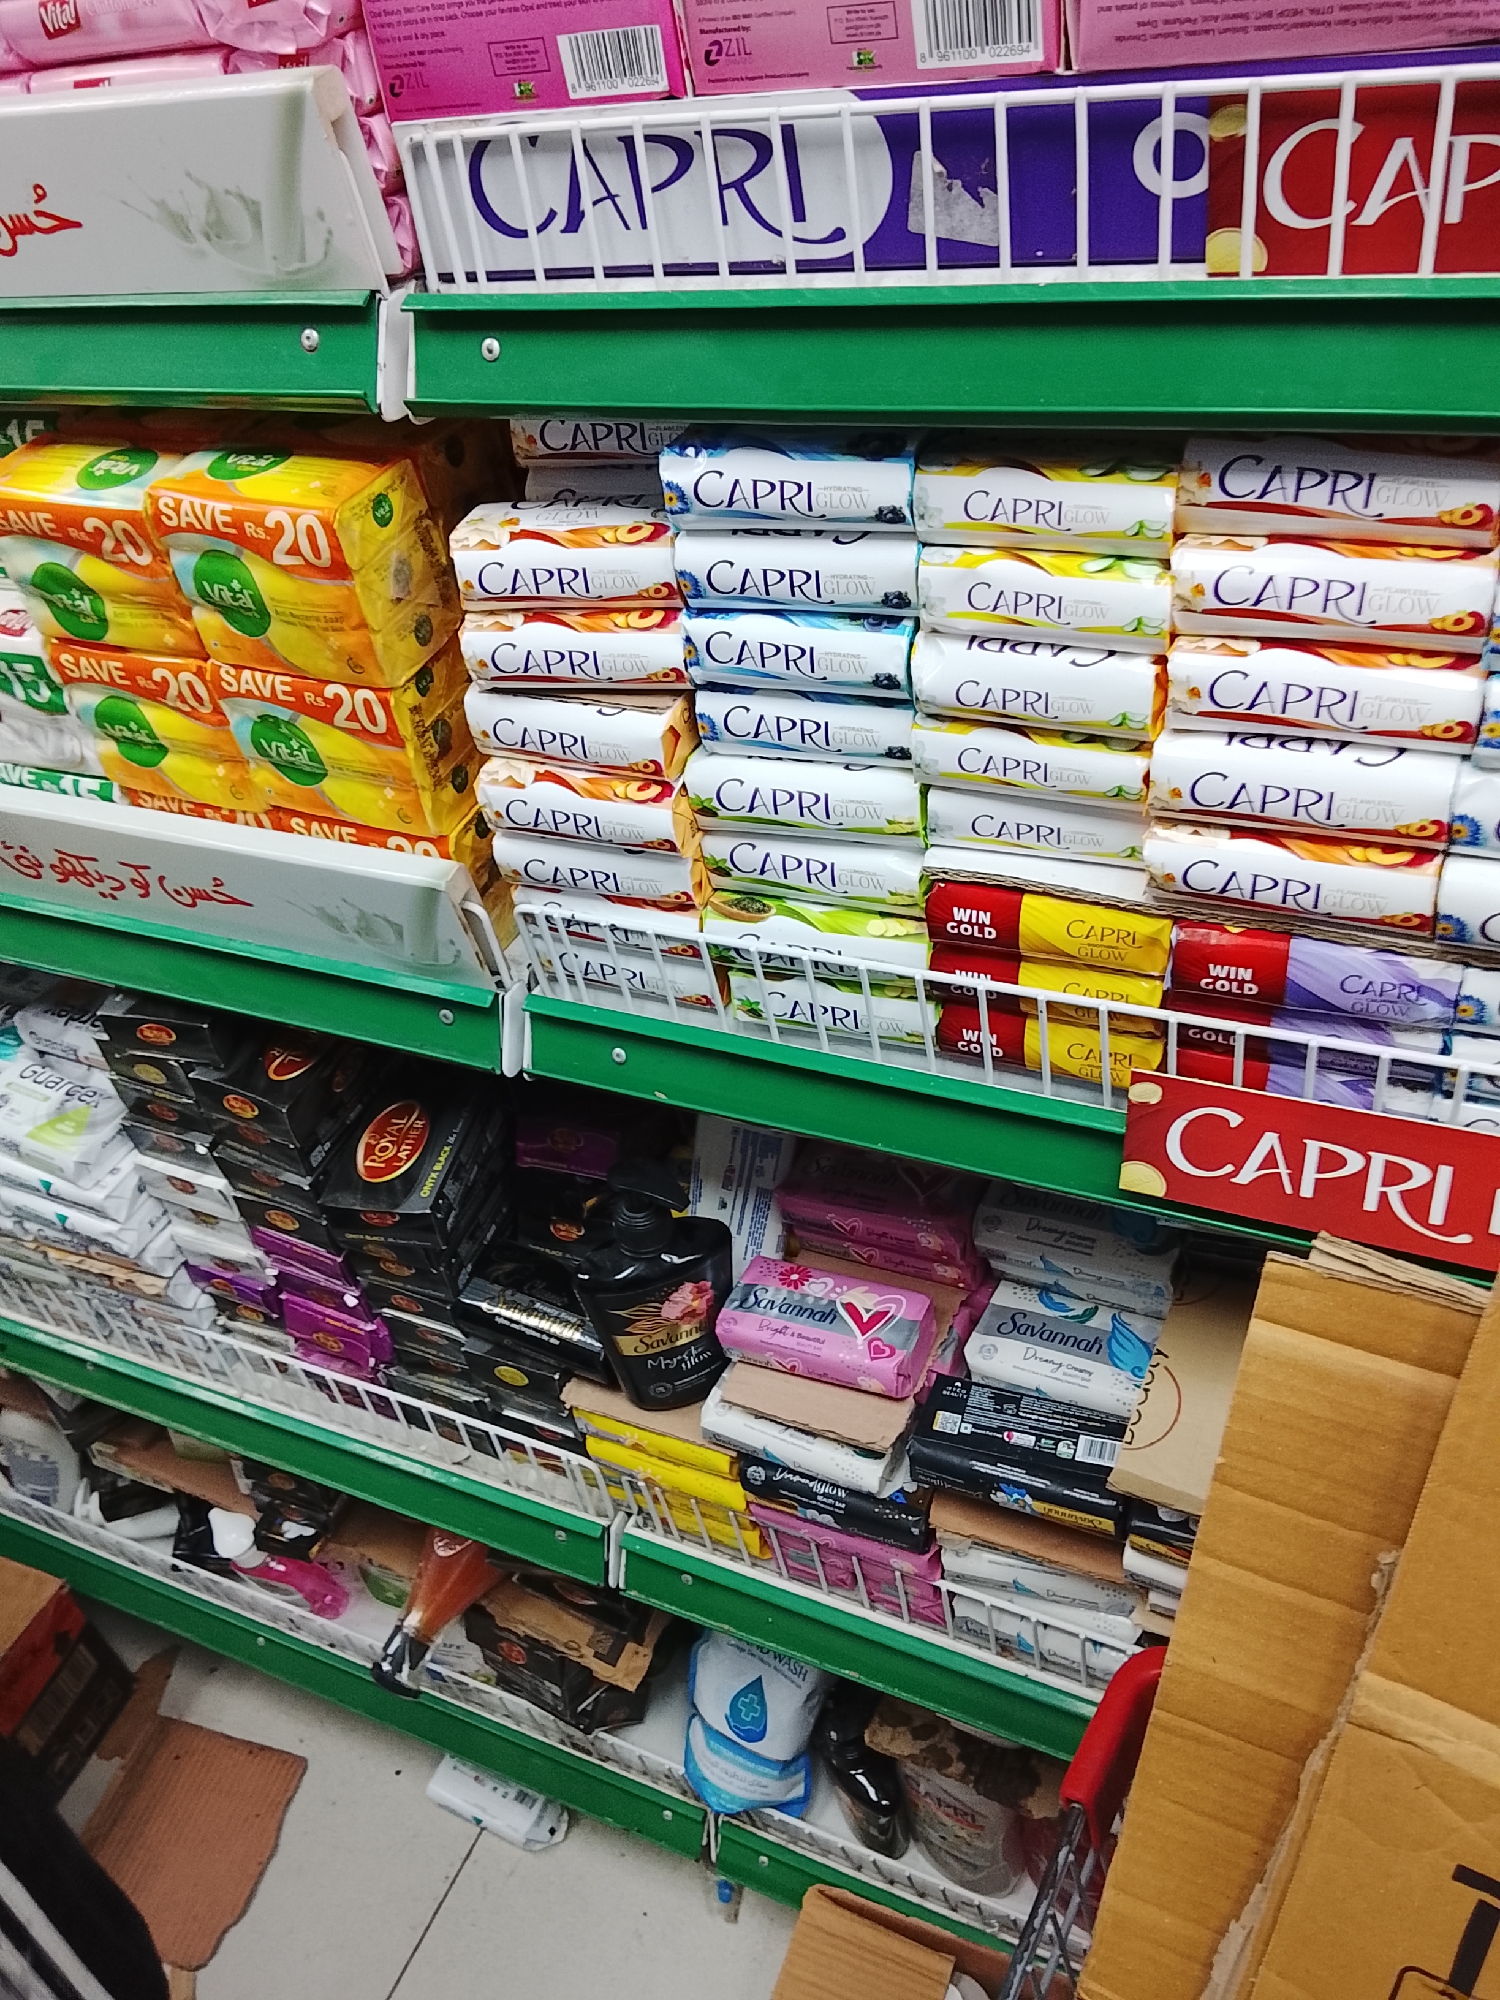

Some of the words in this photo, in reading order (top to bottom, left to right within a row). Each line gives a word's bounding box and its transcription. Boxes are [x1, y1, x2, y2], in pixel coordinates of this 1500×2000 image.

[39, 0, 77, 34] Vital
[699, 26, 741, 36] Manufactured
[722, 37, 753, 57] ZIL
[920, 52, 927, 63] 8
[937, 47, 978, 63] 961100
[989, 44, 1031, 59] 022694
[404, 72, 430, 90] ZIL
[571, 83, 577, 94] 8
[585, 79, 619, 93] 961100
[468, 120, 847, 245] CAPRI
[539, 419, 661, 456] CAPRI
[692, 469, 827, 519] CAPRI
[815, 491, 871, 511] GLOW
[823, 485, 863, 493] HYDRATING
[1218, 453, 1385, 519] CAPRI
[1375, 484, 1451, 510] GLOW
[963, 489, 1072, 532] CAPRI
[1063, 509, 1112, 525] GLOW
[83, 517, 153, 567] 20
[157, 495, 238, 535] SAVE
[243, 521, 271, 541] Rs.
[264, 509, 332, 568] 20
[200, 577, 255, 610] Vital
[477, 561, 604, 599] CAPRI
[590, 574, 642, 590] GLOW
[705, 559, 836, 605] CAPRI
[822, 580, 877, 597] GLOW
[1212, 564, 1377, 626] CAPRI
[967, 581, 1071, 626] CAPRI
[1063, 604, 1111, 620] GLOW
[1367, 594, 1441, 616] GLOW
[490, 642, 614, 682] CAPRI
[601, 658, 650, 674] GLOW
[705, 630, 828, 681] CAPRI
[817, 656, 868, 675] GLOW
[58, 653, 132, 686] SAVE
[152, 667, 214, 714] 20
[219, 665, 296, 702] SAVE
[303, 691, 330, 708] Rs.
[323, 684, 388, 735] 20
[955, 679, 1059, 720] CAPRI
[1050, 698, 1096, 715] GLOW
[1208, 668, 1369, 731] CAPRI
[1359, 700, 1433, 725] GLOW
[492, 717, 600, 765] CAPRI
[722, 704, 843, 753] CAPRI
[831, 730, 882, 749] GLOW
[259, 736, 312, 764] Vital
[587, 744, 632, 763] GLOW
[956, 746, 1057, 789] CAPRI
[1049, 769, 1093, 787] GLOW
[715, 777, 844, 827] CAPRI
[832, 803, 884, 821] GLOW
[1188, 770, 1346, 829] CAPRI
[1335, 803, 1406, 825] GLOW
[505, 798, 614, 844] CAPRI
[602, 824, 646, 841] GLOW
[970, 813, 1071, 851] CAPRI
[1062, 832, 1106, 849] GLOW
[523, 858, 632, 895] CAPRI
[728, 841, 850, 895] CAPRI
[838, 872, 887, 893] GLOW
[1181, 858, 1333, 918] CAPRI
[952, 906, 991, 926] WIN
[1322, 892, 1390, 916] GLOW
[946, 921, 997, 940] GOLD
[1065, 919, 1143, 949] CAPRI
[1076, 945, 1130, 962] GLOW
[1199, 977, 1259, 995] GOLD
[1208, 963, 1253, 981] WIN
[950, 984, 998, 1000] GOD
[1338, 973, 1427, 1007] CAPRI
[1350, 1000, 1411, 1018] GLOW
[957, 1041, 1004, 1058] GOD
[363, 1114, 409, 1168] ROYAL
[392, 1117, 426, 1167] LATHER
[419, 1169, 440, 1198] ONYX
[432, 1144, 451, 1171] BLACK
[1165, 1106, 1474, 1245] CAPRI
[731, 1286, 839, 1327] Savannah
[755, 1318, 790, 1340] Bright
[996, 1311, 1103, 1356] Savannah
[1022, 1346, 1066, 1374] Dreamy
[768, 1651, 808, 1683] WASH
